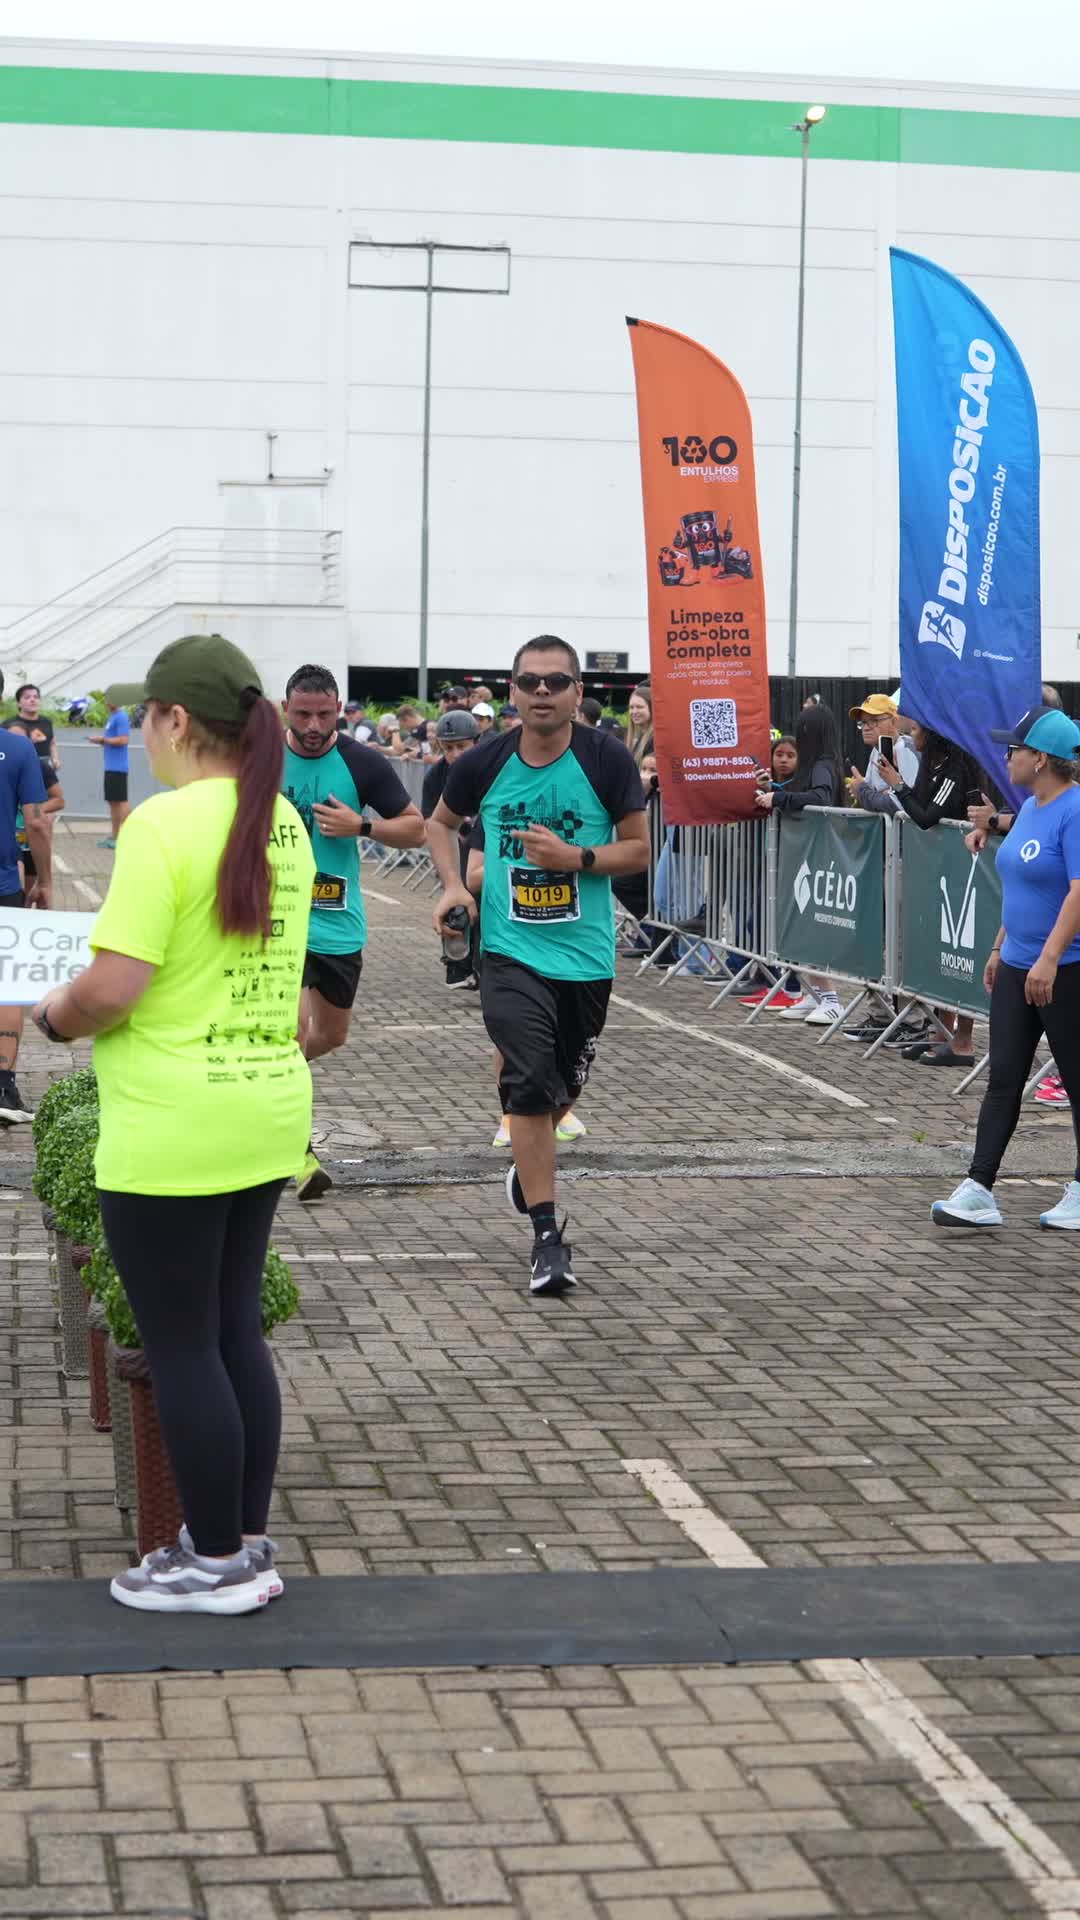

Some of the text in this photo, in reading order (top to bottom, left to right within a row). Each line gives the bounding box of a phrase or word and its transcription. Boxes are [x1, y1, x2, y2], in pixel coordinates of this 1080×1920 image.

[680, 466, 739, 476] ENTULHOS
[978, 464, 1008, 606] disposicao.com.br
[671, 609, 744, 627] Limpeza
[667, 626, 750, 646] pós-obra
[667, 641, 752, 661] completa
[682, 757, 701, 768] (43)
[268, 825, 298, 848] AFF
[313, 884, 333, 896] 79
[523, 886, 563, 903] 1019
[813, 860, 857, 912] CÉLO
[0, 954, 87, 982] Tráfe
